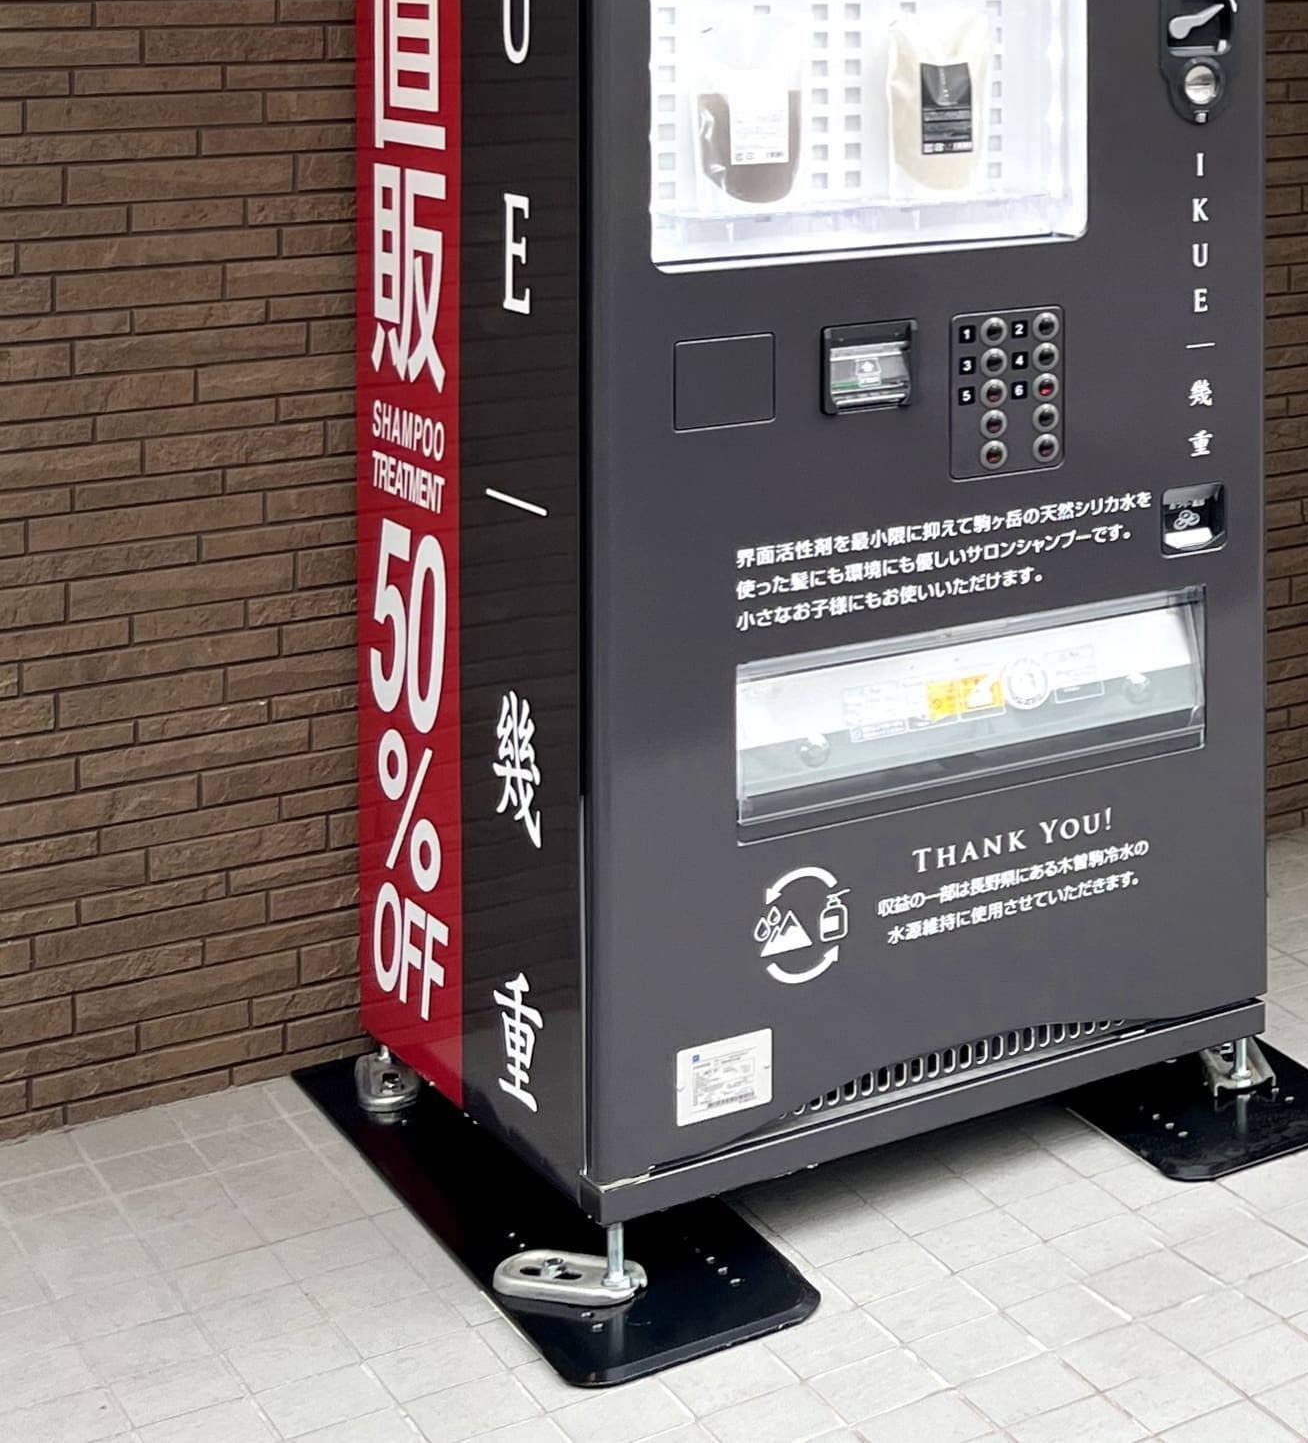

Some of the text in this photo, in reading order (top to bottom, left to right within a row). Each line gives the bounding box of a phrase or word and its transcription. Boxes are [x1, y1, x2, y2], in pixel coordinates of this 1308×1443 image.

[1192, 153, 1209, 312] IKUE
[963, 328, 971, 340] 1
[1015, 323, 1024, 335] 2
[1015, 355, 1024, 366] 4
[963, 359, 972, 371] 3
[963, 390, 972, 402] 5
[1015, 384, 1024, 396] 6
[372, 399, 445, 462] SHAMPOO
[1188, 379, 1213, 457] 幾重
[372, 449, 446, 515] TREATMENT
[735, 566, 1044, 632] 小さなお子様にもお使いいただけます。
[911, 829, 1027, 874] THANK
[492, 690, 544, 1113] 幾重
[886, 869, 1140, 946] 水源維持に使用させていただきます。
[373, 881, 449, 1021] OFF
